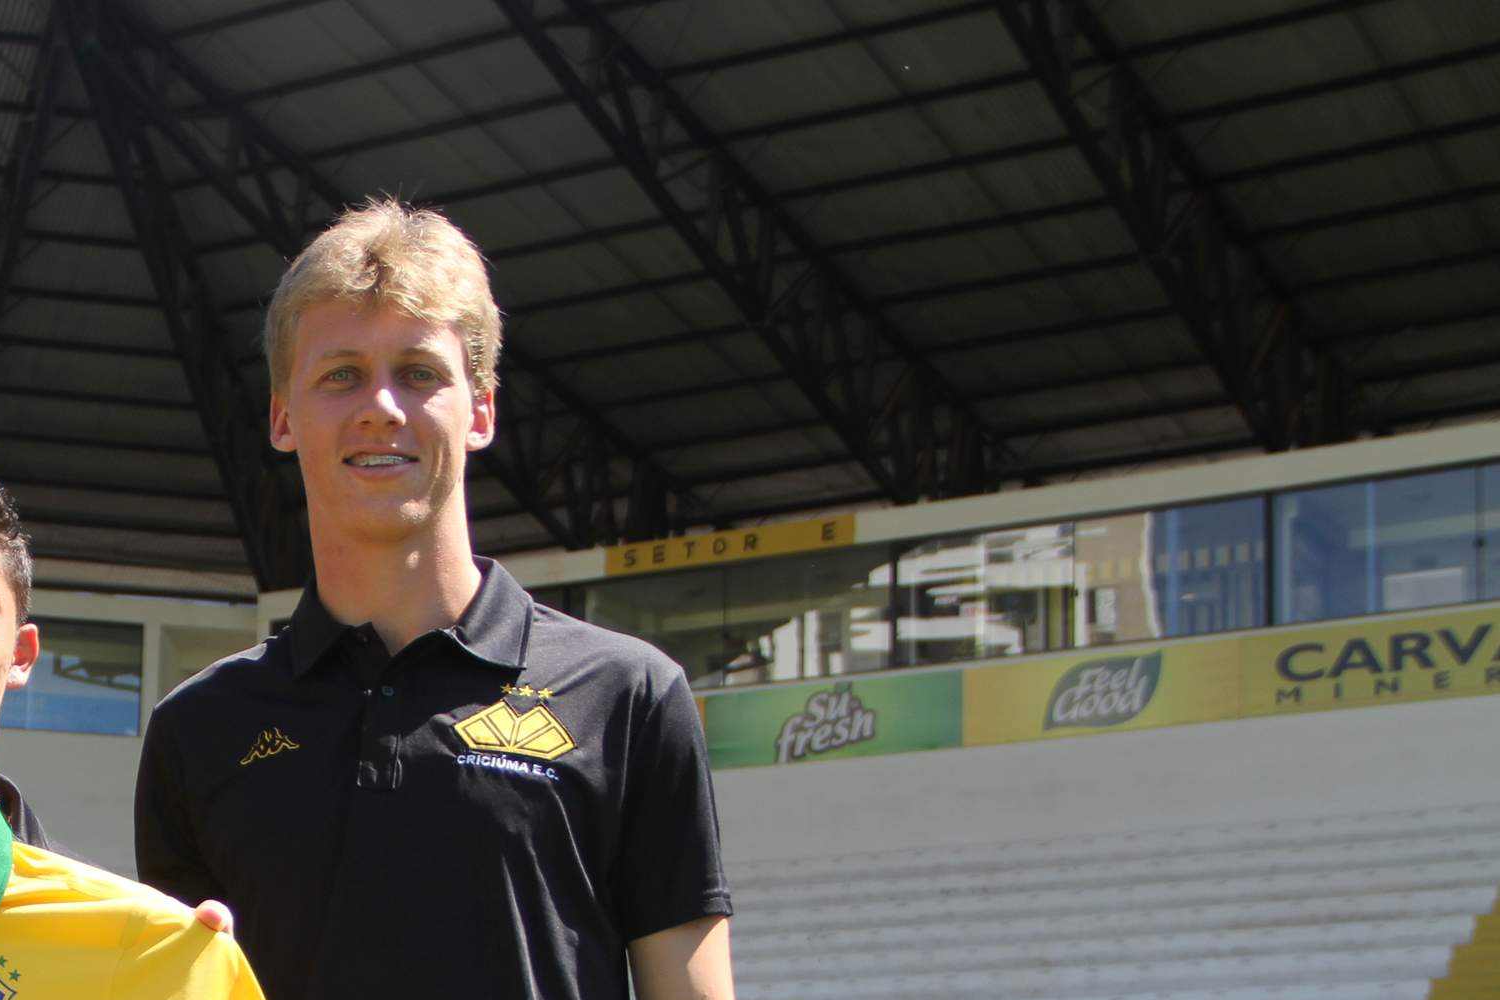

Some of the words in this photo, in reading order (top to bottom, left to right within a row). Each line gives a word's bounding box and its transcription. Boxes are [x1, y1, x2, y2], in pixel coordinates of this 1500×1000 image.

[623, 533, 759, 568] SETOR
[821, 521, 837, 542] E
[1275, 623, 1500, 682] CARV
[1051, 674, 1148, 723] Good
[1077, 656, 1143, 698] Feel
[778, 709, 875, 763] fresh
[456, 754, 529, 774] CRICIÚMA
[531, 764, 560, 781] E.C.
